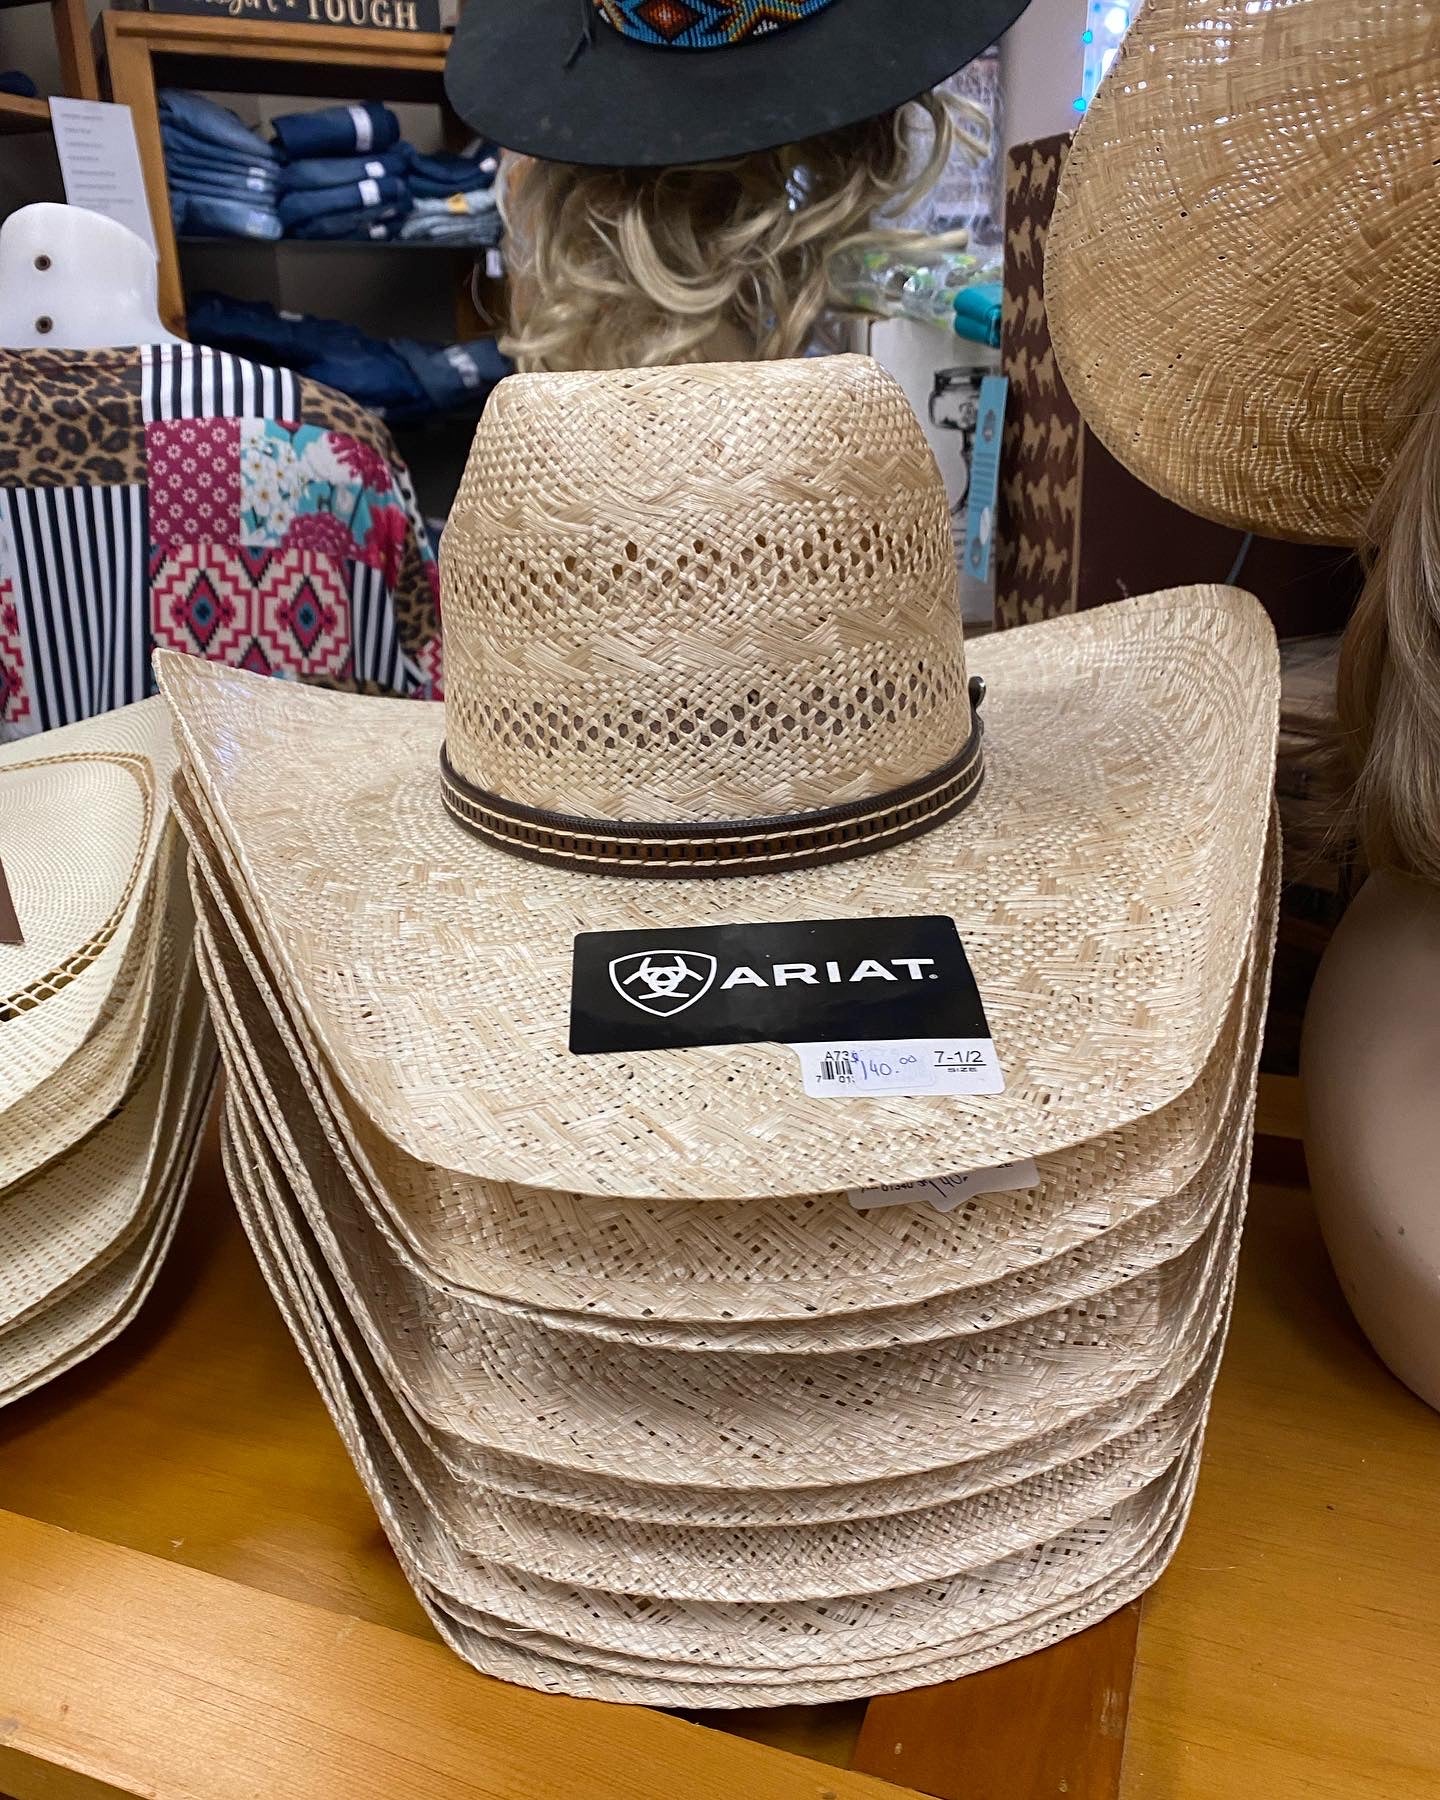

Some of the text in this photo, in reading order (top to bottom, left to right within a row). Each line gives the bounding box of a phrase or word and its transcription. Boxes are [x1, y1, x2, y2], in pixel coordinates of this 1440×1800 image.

[308, 0, 418, 31] TOUGH
[719, 958, 935, 990] ARIAT
[934, 1050, 984, 1064] 7-1/2
